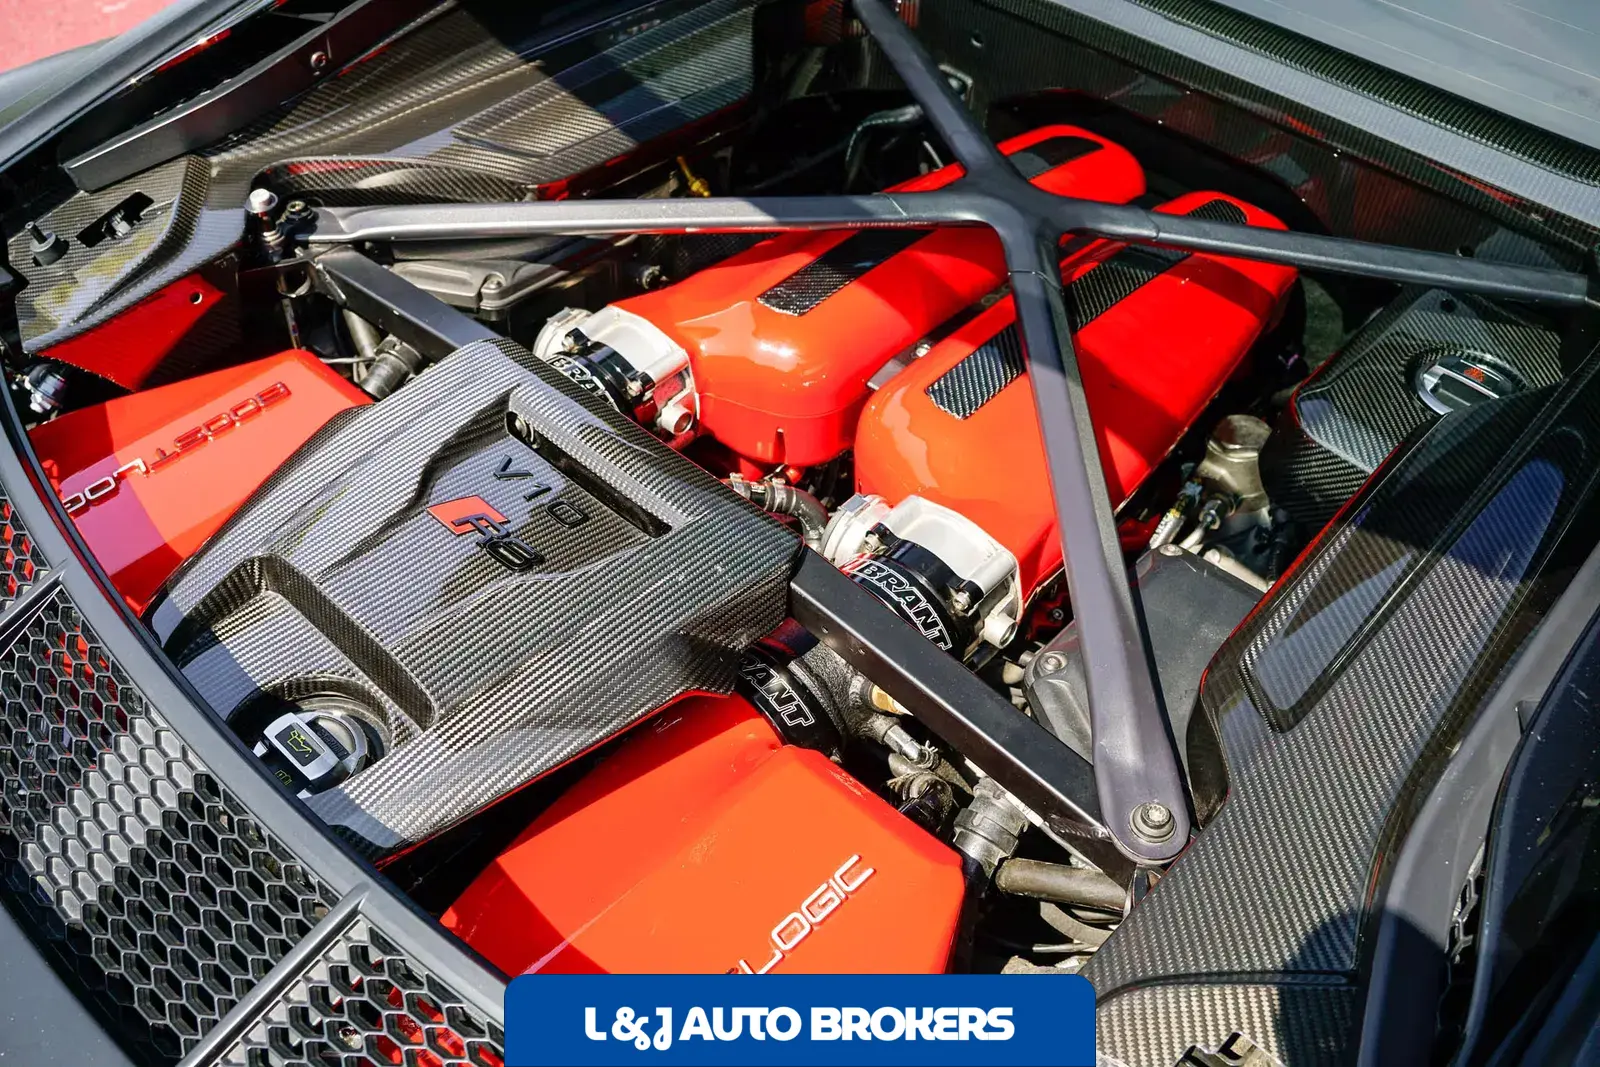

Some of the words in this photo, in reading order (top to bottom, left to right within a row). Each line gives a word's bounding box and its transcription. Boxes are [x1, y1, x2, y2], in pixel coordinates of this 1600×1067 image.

[493, 455, 588, 528] V10
[451, 512, 546, 572] R8
[725, 854, 877, 974] LOGIC
